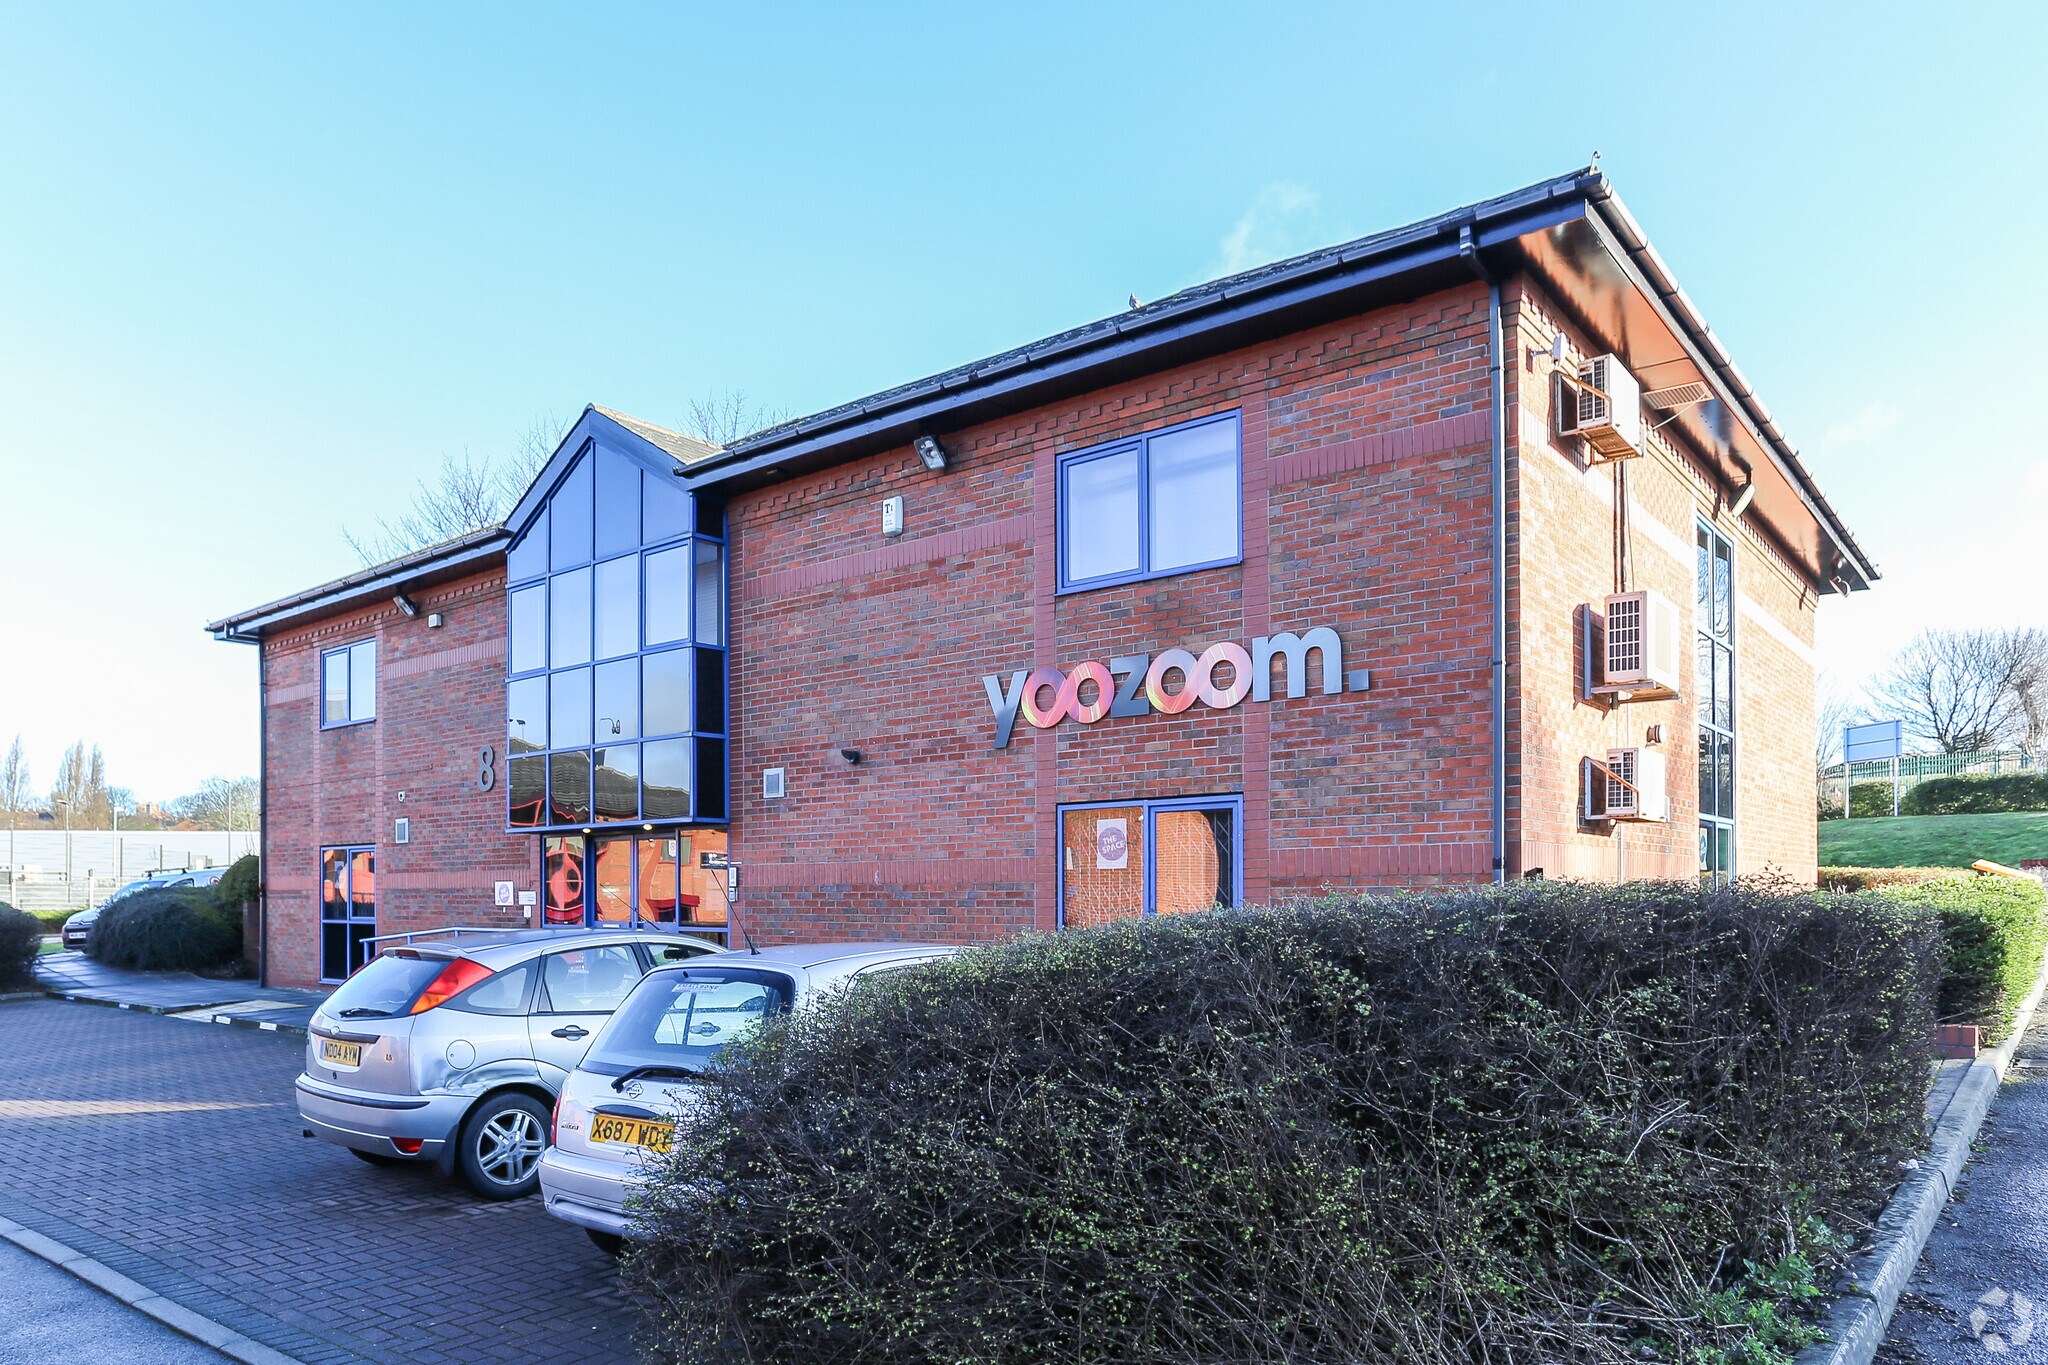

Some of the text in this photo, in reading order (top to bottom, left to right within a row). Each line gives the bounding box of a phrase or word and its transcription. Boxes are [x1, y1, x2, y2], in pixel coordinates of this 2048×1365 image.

[478, 745, 494, 791] 8
[1102, 834, 1117, 845] THE
[1102, 840, 1125, 854] SPACE
[342, 1045, 358, 1063] AYM
[592, 1117, 635, 1143] X687
